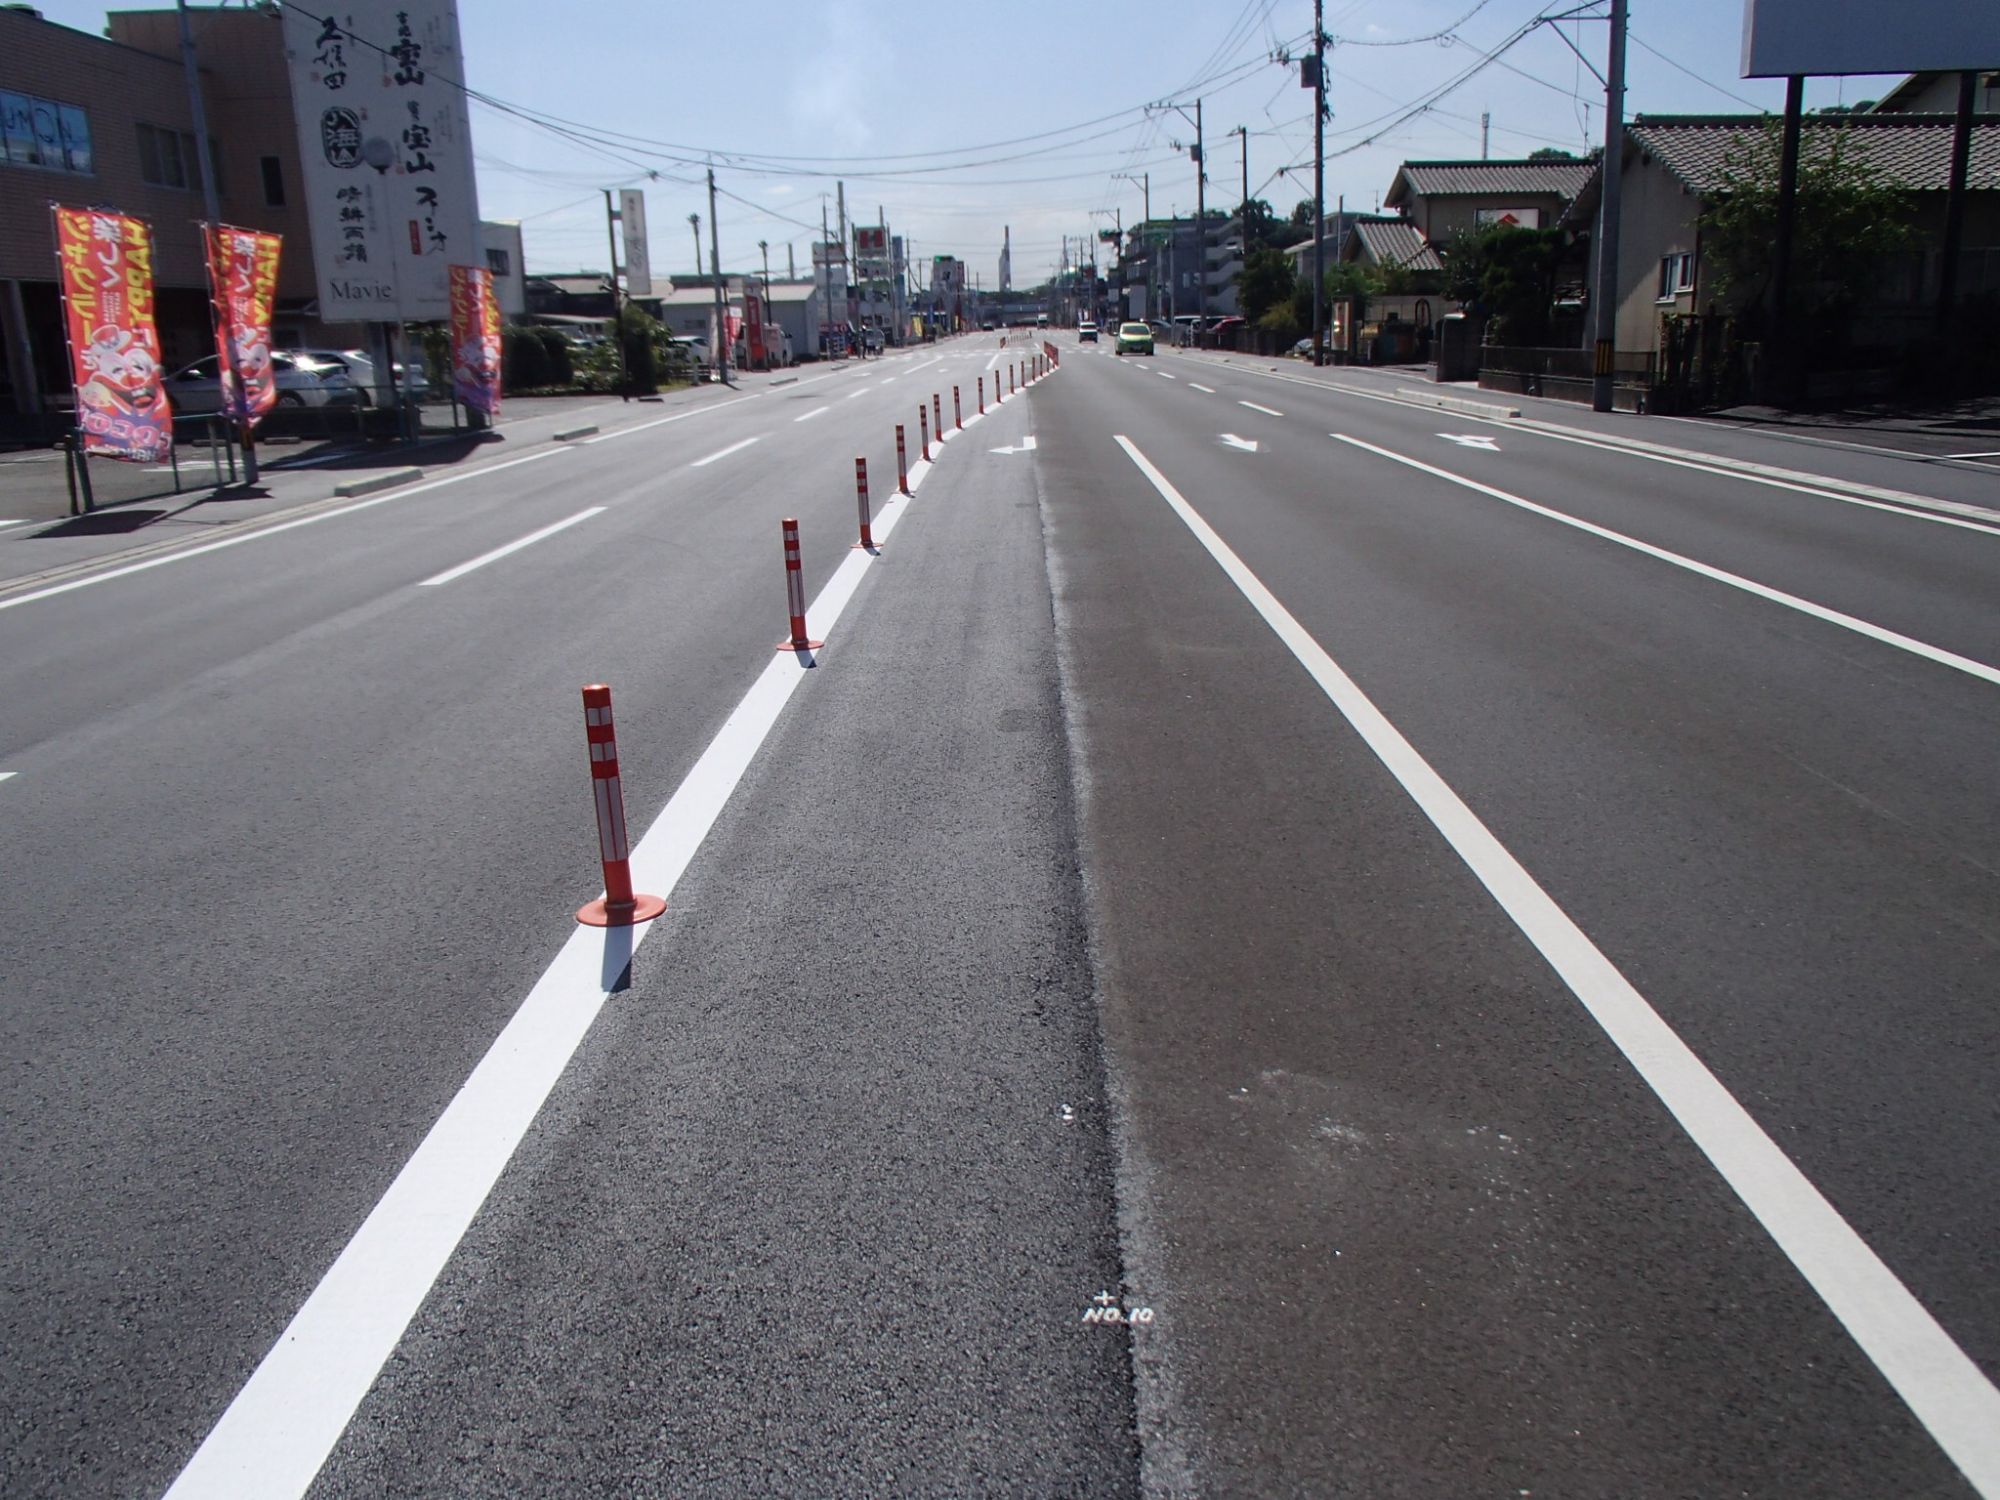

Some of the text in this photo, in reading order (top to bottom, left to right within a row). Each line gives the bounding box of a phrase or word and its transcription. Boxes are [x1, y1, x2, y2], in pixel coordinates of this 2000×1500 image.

[313, 16, 348, 91] 久保田
[330, 279, 393, 301] Mavie
